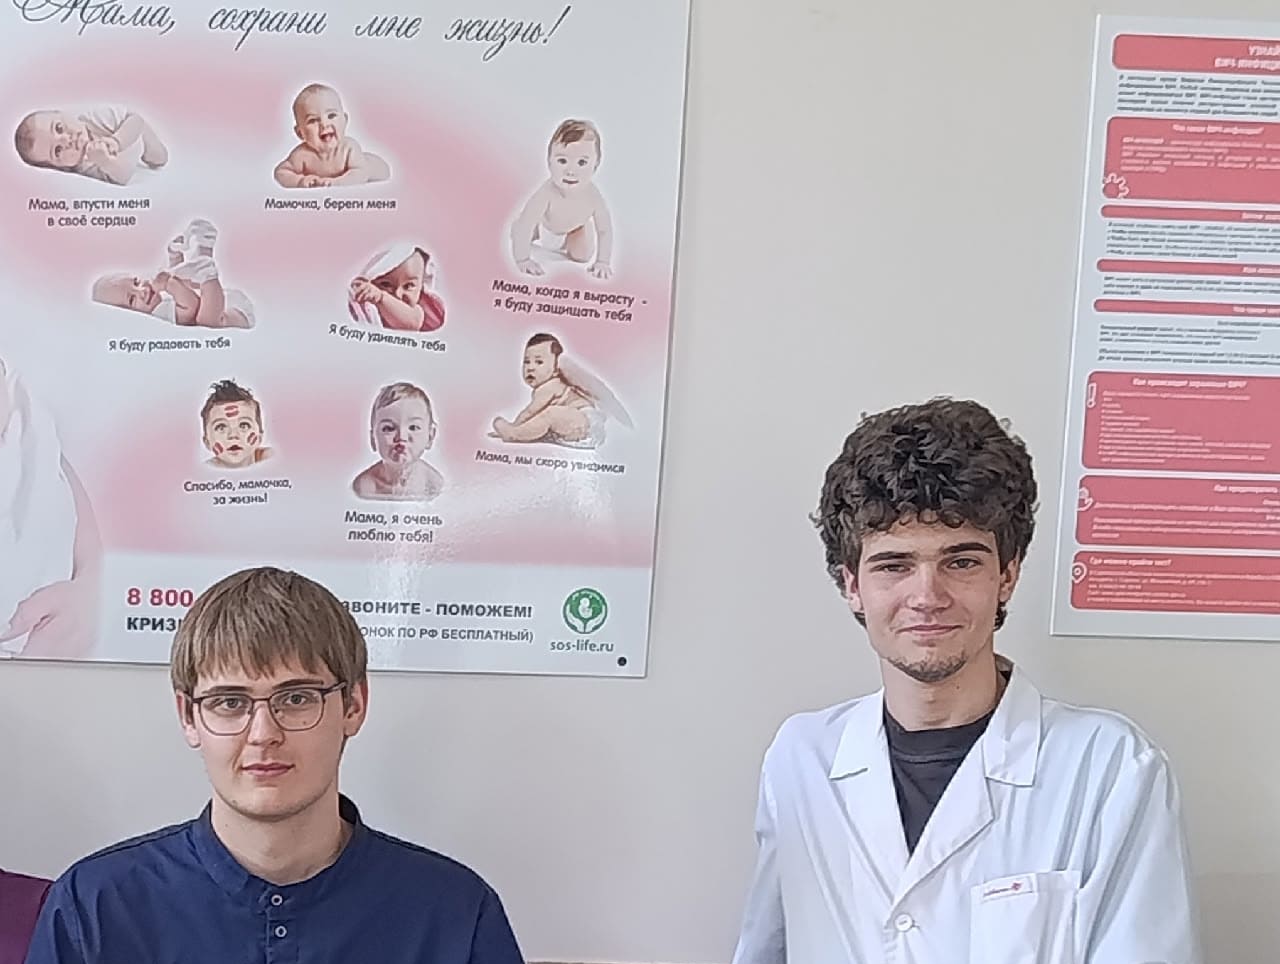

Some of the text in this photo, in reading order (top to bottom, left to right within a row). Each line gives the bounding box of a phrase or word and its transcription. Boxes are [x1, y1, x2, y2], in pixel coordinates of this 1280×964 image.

[208, 7, 326, 51] сохрани
[354, 15, 422, 39] мне
[444, 4, 571, 62] жизнь!
[27, 198, 150, 212] Мама, впусти меня
[264, 198, 320, 211] Мамочка,
[366, 199, 397, 209] меня
[47, 214, 137, 229] в своё сердце
[492, 279, 532, 295] Мама,
[535, 286, 570, 299] когда
[573, 290, 581, 300] я
[583, 292, 634, 307] вырасту
[494, 298, 633, 321] я буду защищать тебя
[108, 336, 231, 353] Я буду радовать тебя
[328, 323, 447, 352] Я буду удивлять тебя
[475, 450, 512, 464] Мама,
[515, 456, 533, 465] мы
[535, 458, 568, 470] скоро
[183, 479, 292, 492] Спасибо, мамочка,
[344, 511, 443, 526] Мама, я очень
[348, 528, 433, 543] люблю тебя!
[127, 587, 141, 606] 8
[150, 588, 194, 608] 800
[435, 603, 532, 618] ПОМОЖЕМ!
[127, 616, 183, 632] КРИЗ
[398, 627, 417, 639] ПО
[419, 628, 438, 639] РФ
[441, 628, 534, 643] БЕСПЛАТНЫЙ)
[549, 639, 615, 652] sos-life.ru
